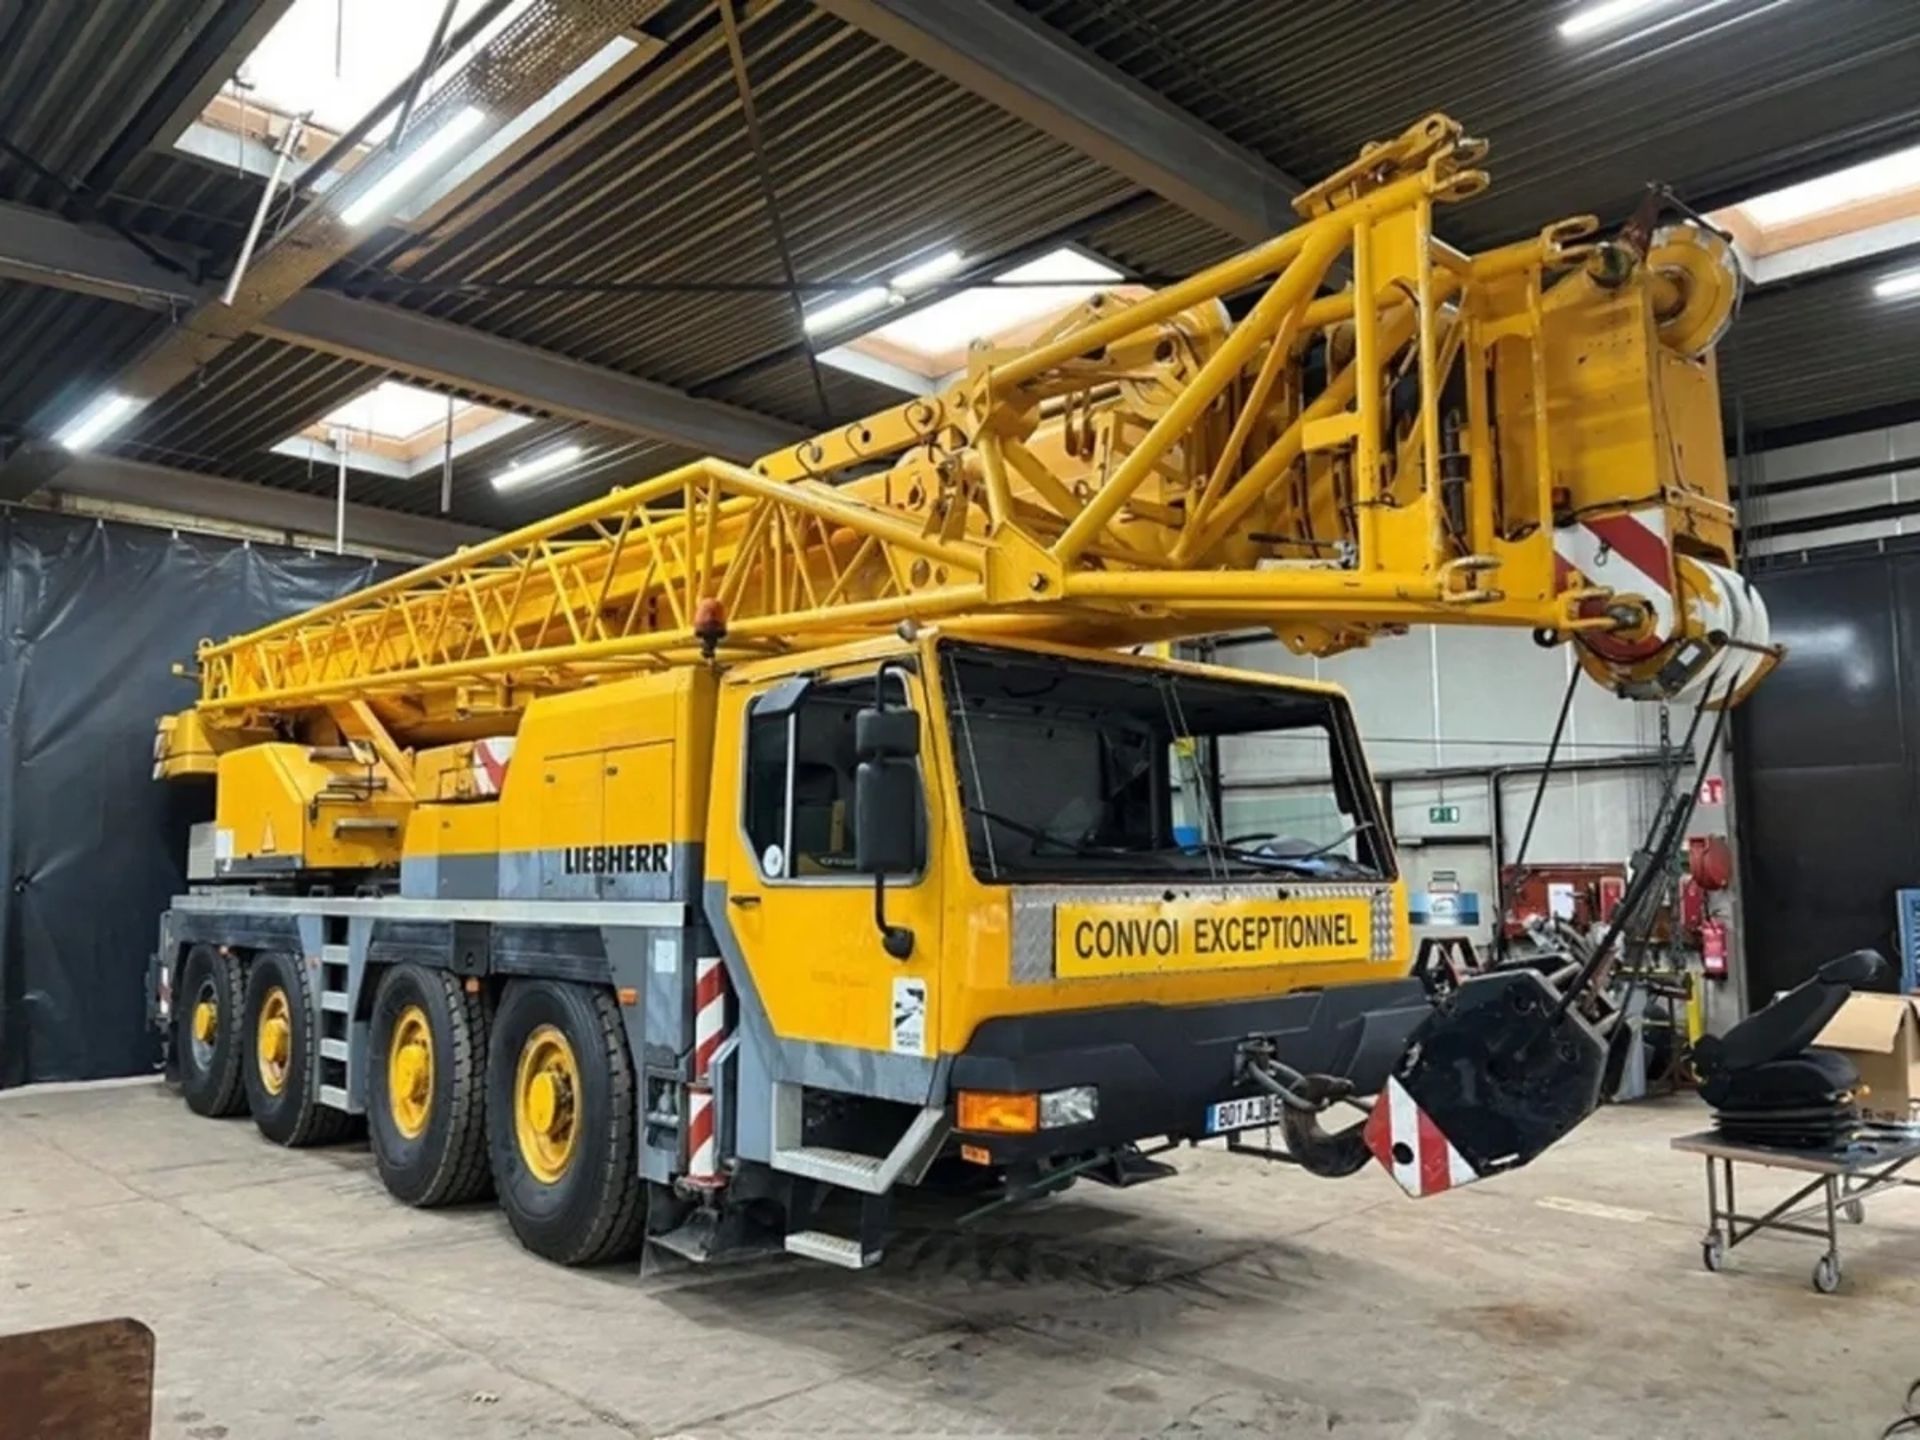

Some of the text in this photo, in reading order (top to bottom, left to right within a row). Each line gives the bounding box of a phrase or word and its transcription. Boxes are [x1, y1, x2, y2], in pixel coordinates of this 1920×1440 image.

[565, 842, 669, 875] LIEBHERR
[1074, 913, 1358, 959] CONVOI EXCEPTIONNEL
